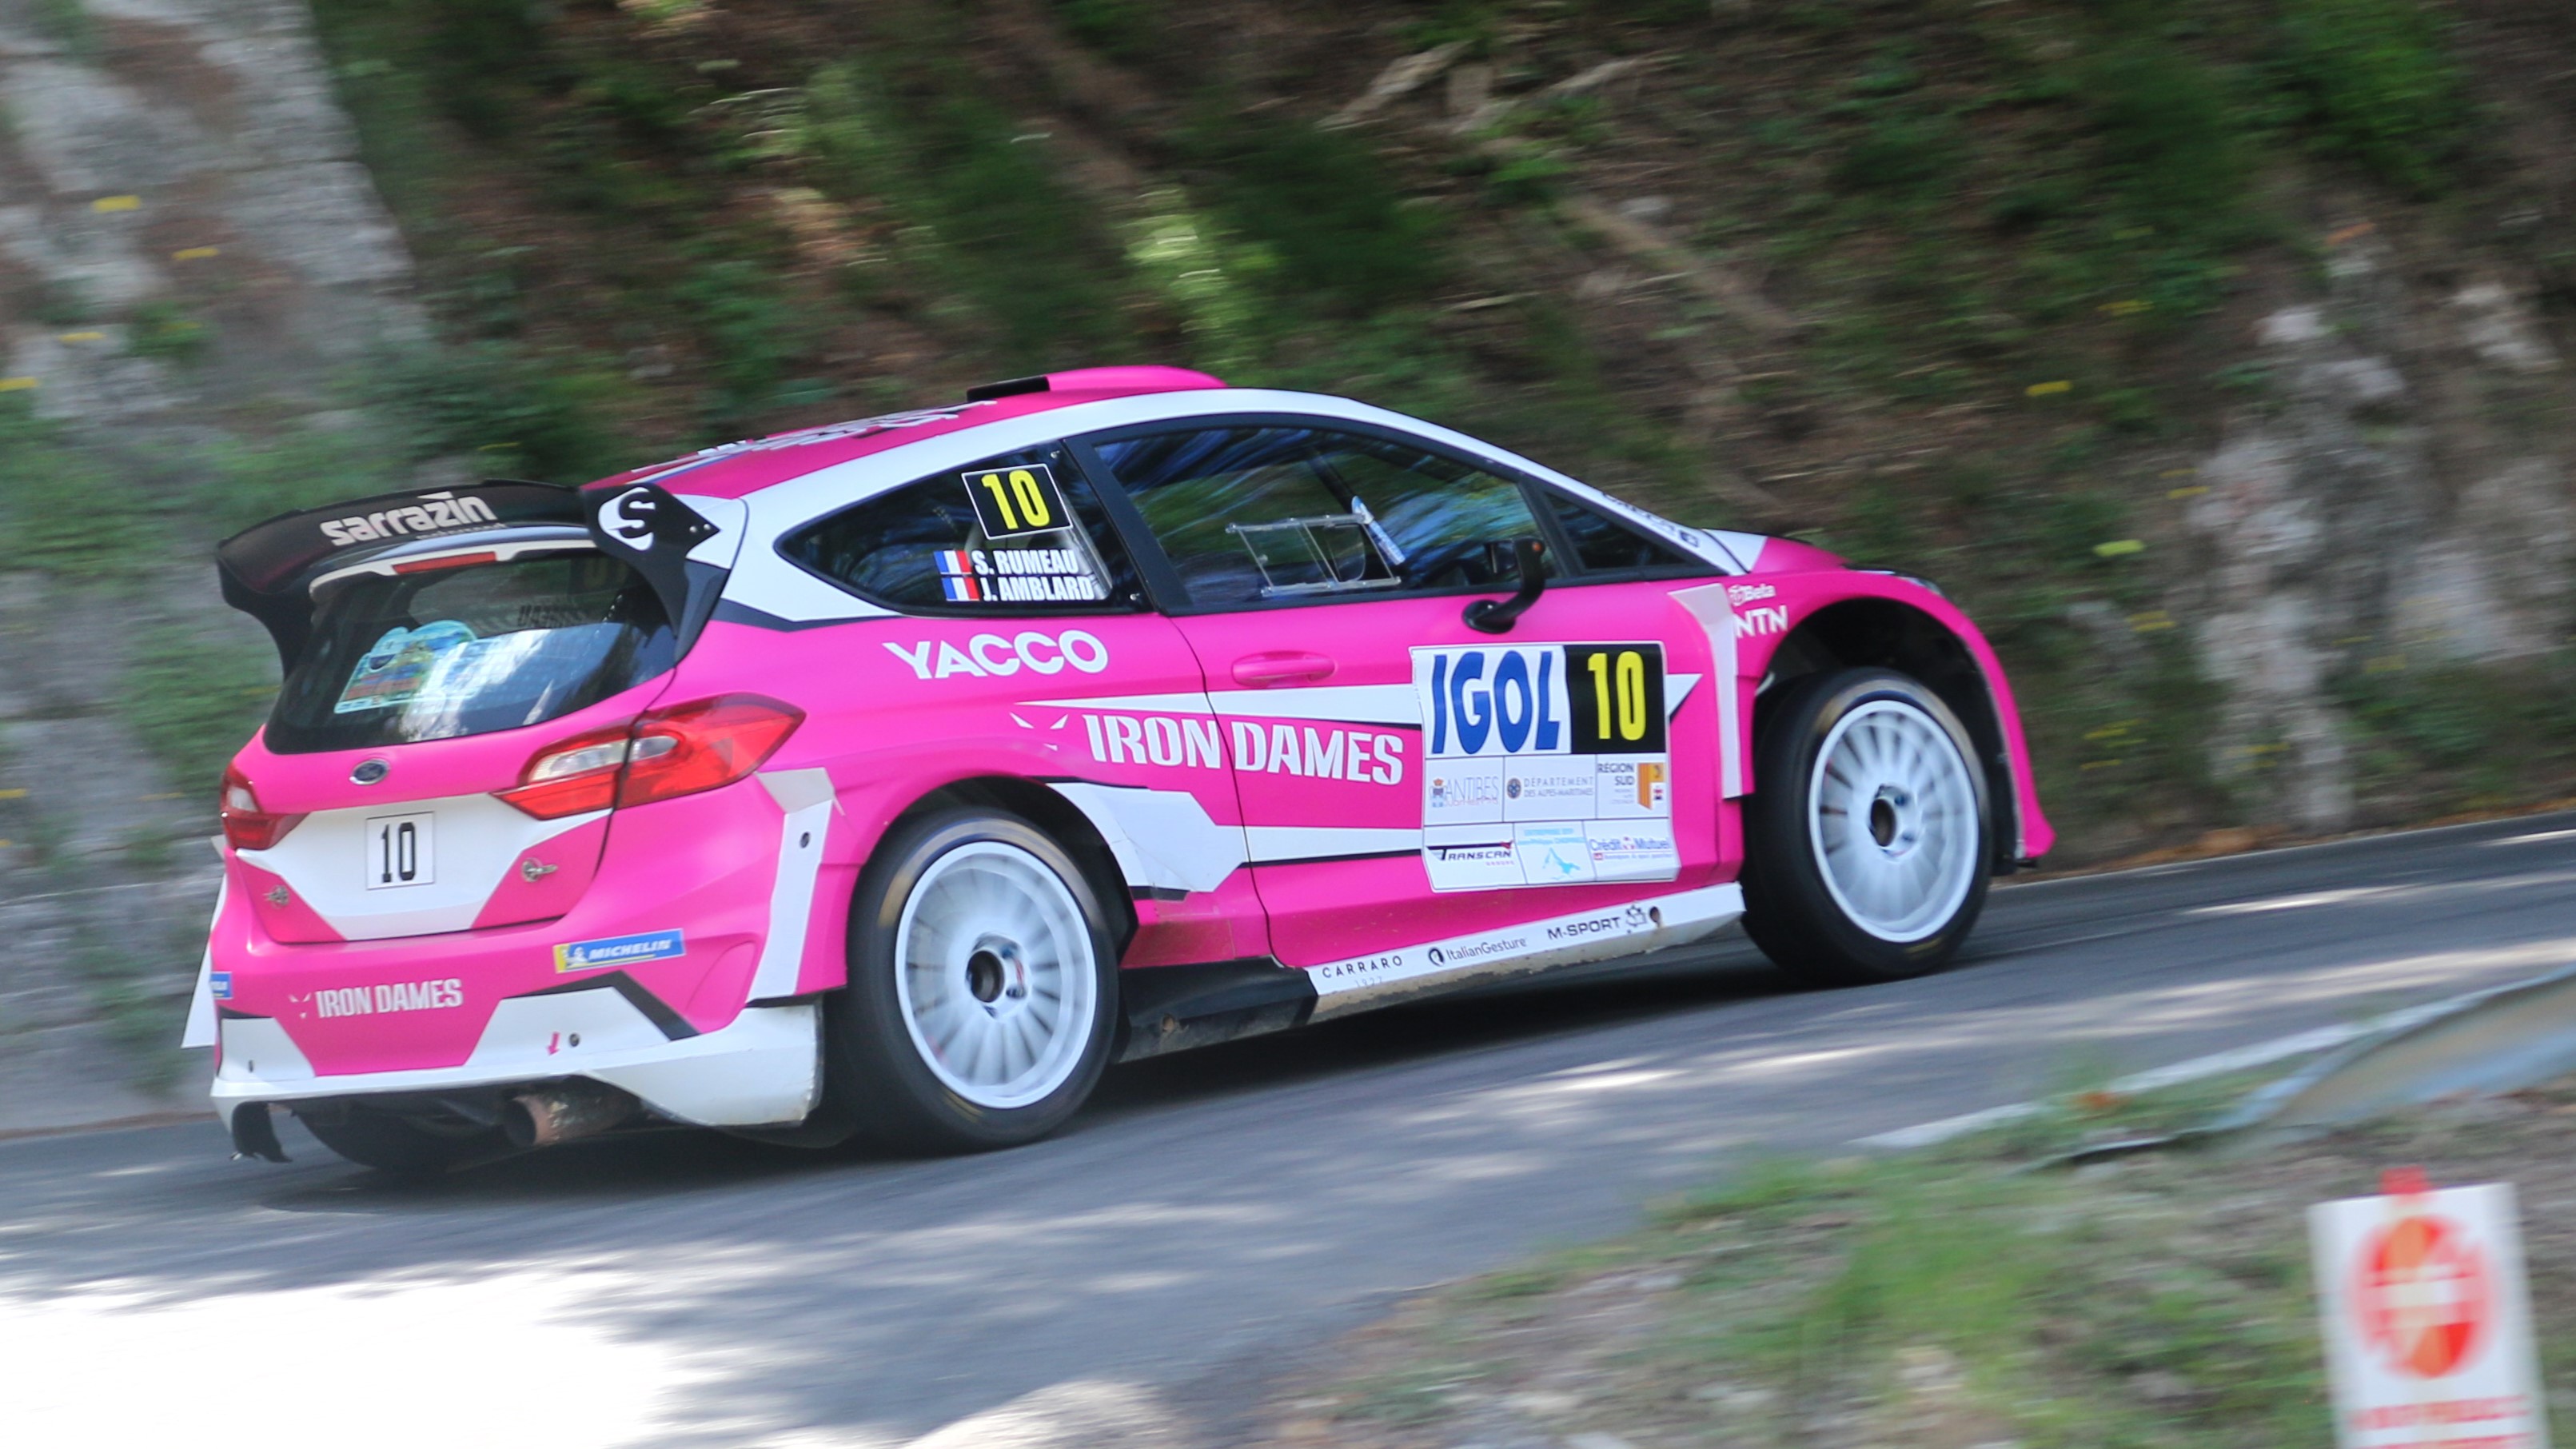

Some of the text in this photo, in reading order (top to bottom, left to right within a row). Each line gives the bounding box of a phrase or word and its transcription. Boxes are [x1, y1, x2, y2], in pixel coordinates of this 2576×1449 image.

[981, 469, 1051, 529] 10
[971, 549, 1079, 575] S. RUMEAU
[979, 576, 1095, 601] J. AMBLARD
[1733, 604, 1788, 639] NTN
[882, 629, 1109, 680] YACCO
[1431, 650, 1647, 755] IGOL 10
[1083, 713, 1404, 786] IRON DAMES
[1445, 775, 1500, 802] ANTIBES
[381, 820, 416, 884] 10
[1547, 916, 1621, 940] M-SPORT
[588, 938, 672, 960] MICHELIN
[1445, 937, 1527, 961] ItalianGesture
[1322, 955, 1403, 979] CARRARO
[315, 977, 464, 1019] IRON DAMES
